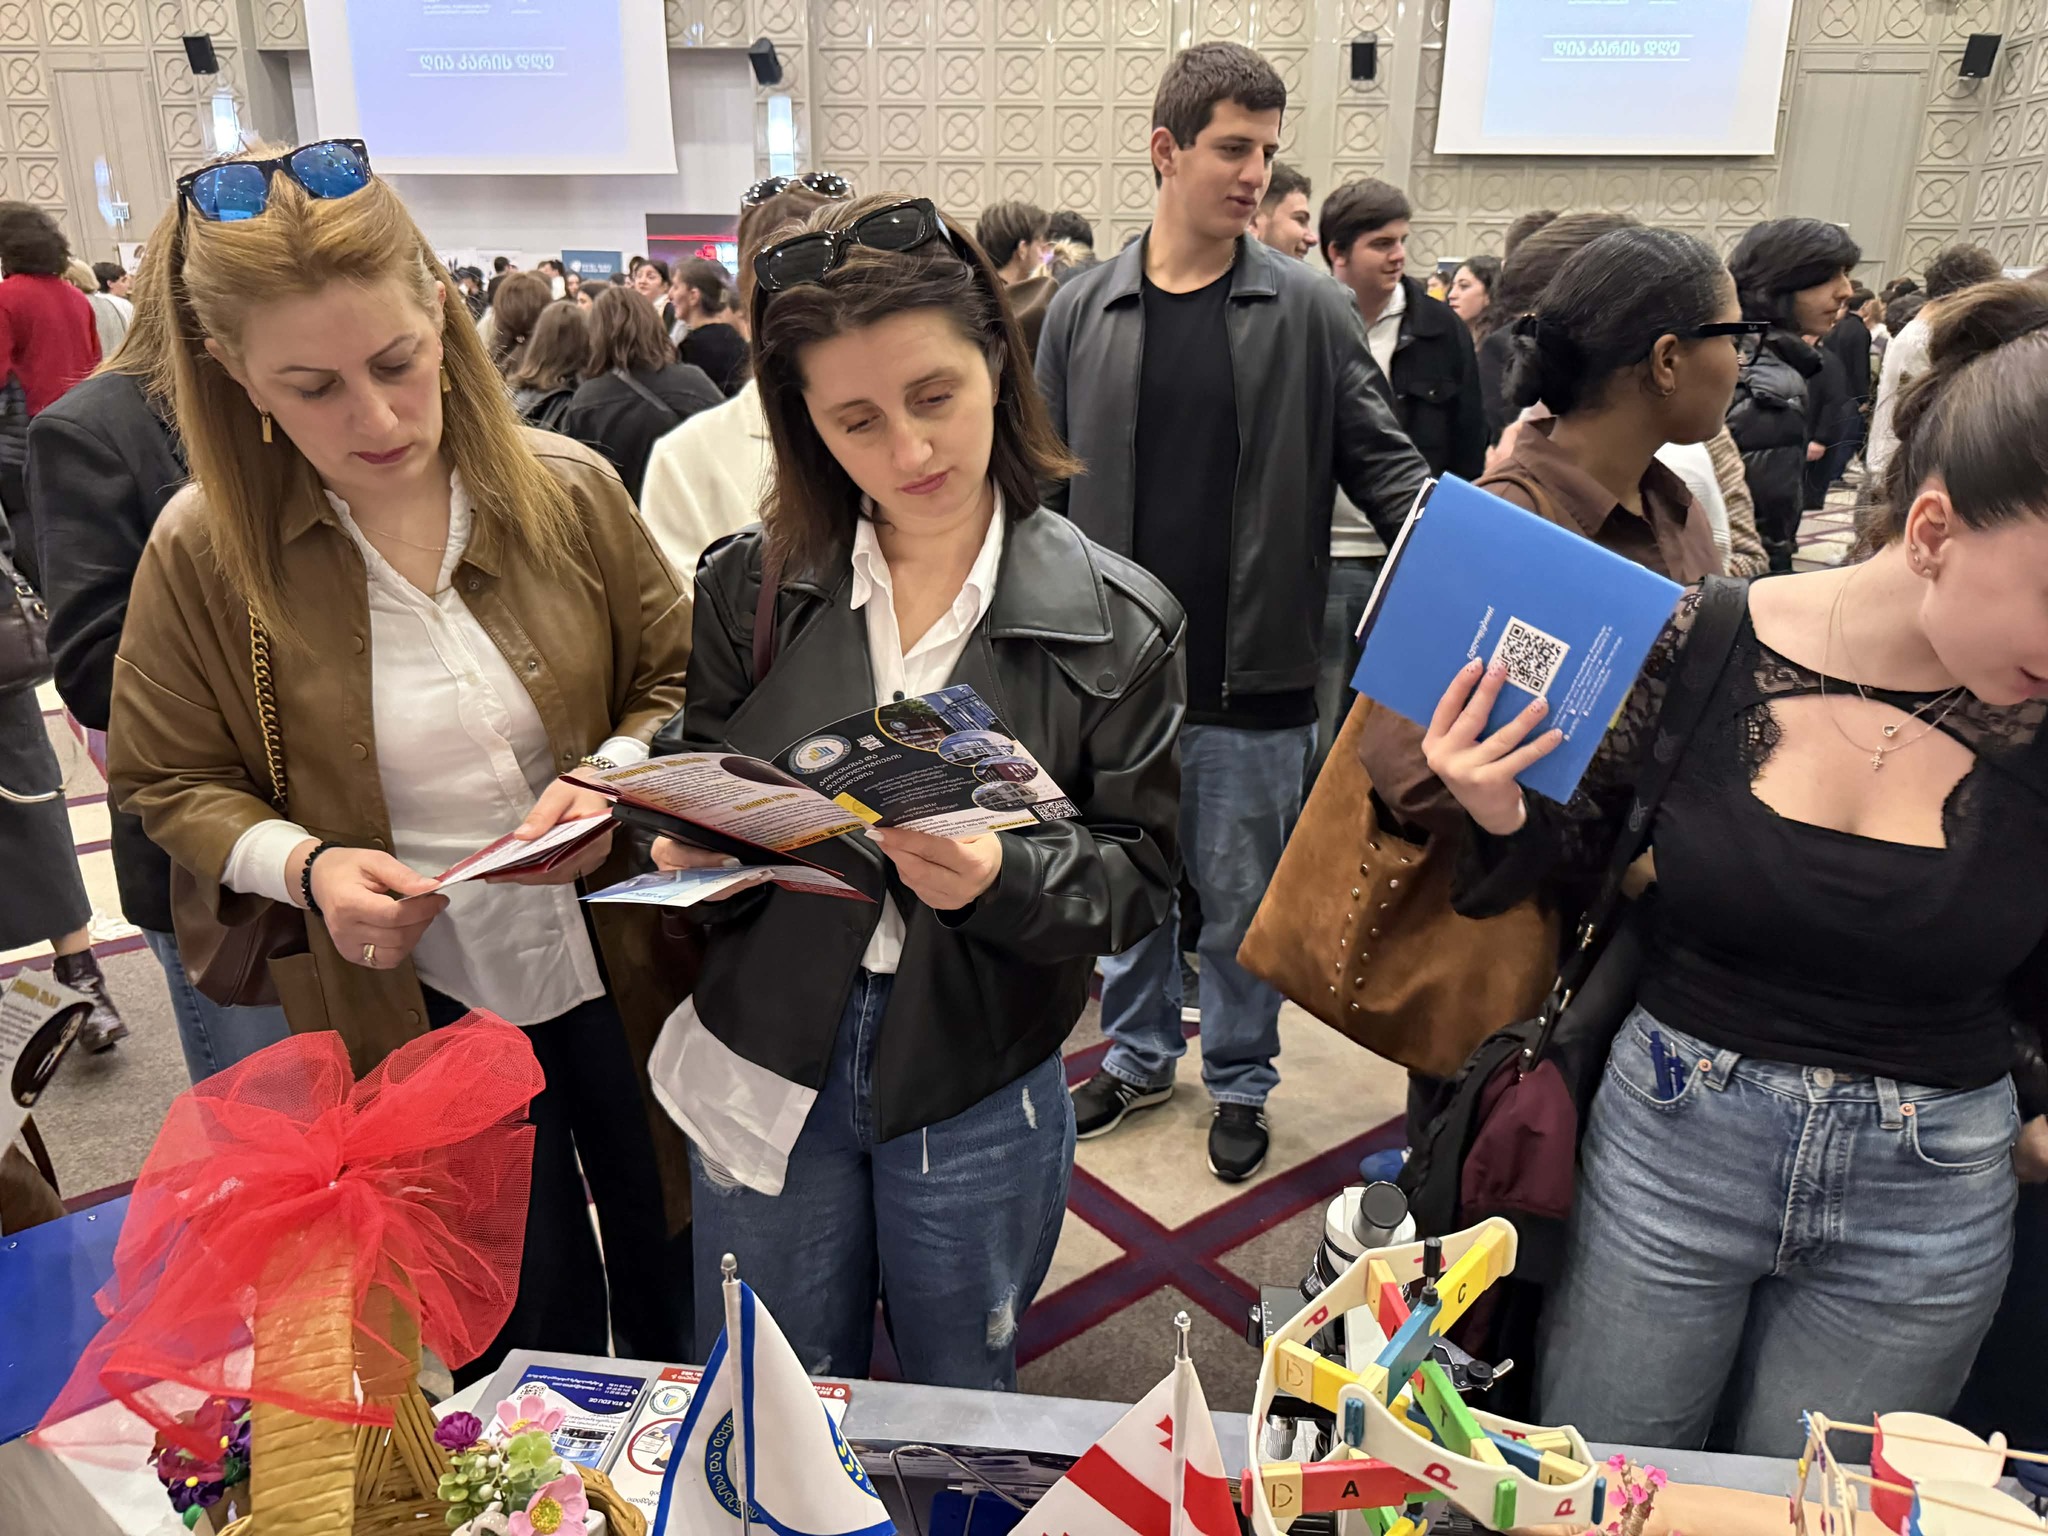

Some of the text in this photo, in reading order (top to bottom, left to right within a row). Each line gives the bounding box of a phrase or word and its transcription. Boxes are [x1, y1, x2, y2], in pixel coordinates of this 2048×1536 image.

[1553, 40, 1680, 56] ღია კარის დღე
[420, 53, 554, 71] ღია კარის დღე
[864, 753, 879, 762] და
[832, 770, 875, 795] აკადემია
[1458, 1282, 1467, 1304] C
[1304, 1305, 1329, 1327] P
[709, 1451, 722, 1472] და
[1423, 1462, 1458, 1490] P
[1272, 1483, 1293, 1508] D
[1341, 1480, 1360, 1498] A
[1554, 1498, 1576, 1517] P
